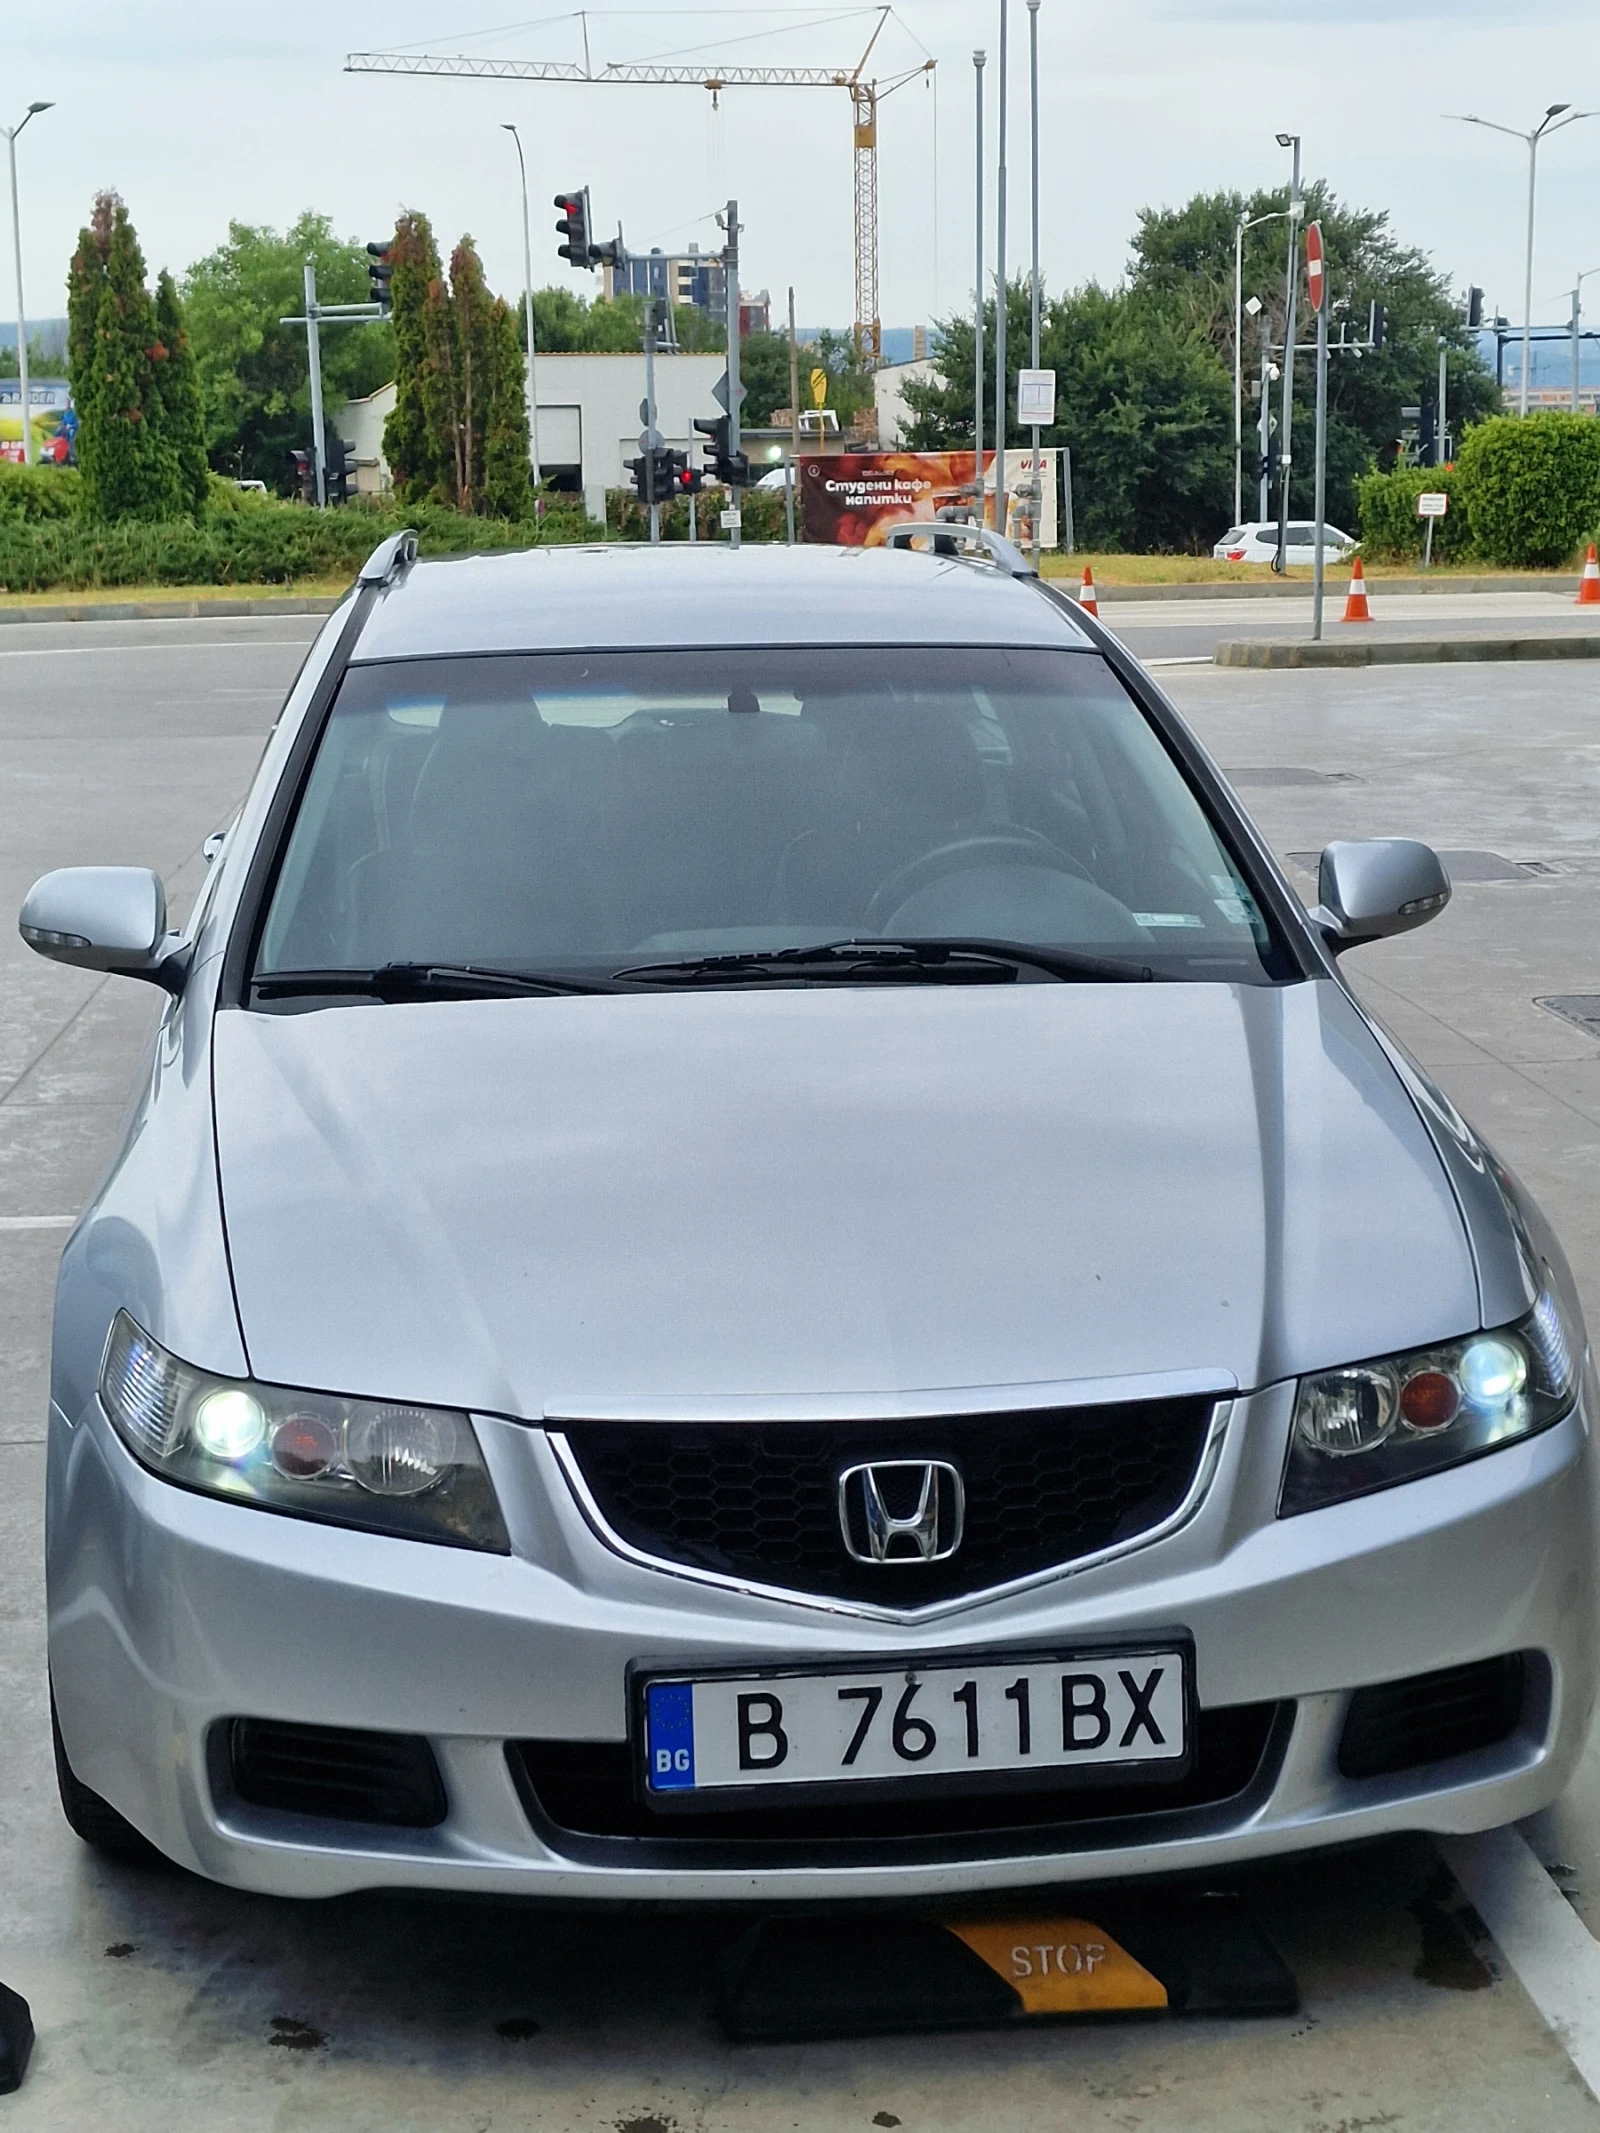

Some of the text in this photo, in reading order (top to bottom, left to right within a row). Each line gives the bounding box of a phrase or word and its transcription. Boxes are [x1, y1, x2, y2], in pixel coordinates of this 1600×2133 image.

[1020, 459, 1047, 470] VIA
[825, 478, 932, 494] Студени кафе
[845, 493, 912, 505] напитки
[656, 1748, 690, 1773] BG
[1011, 1943, 1106, 1977] STOP
